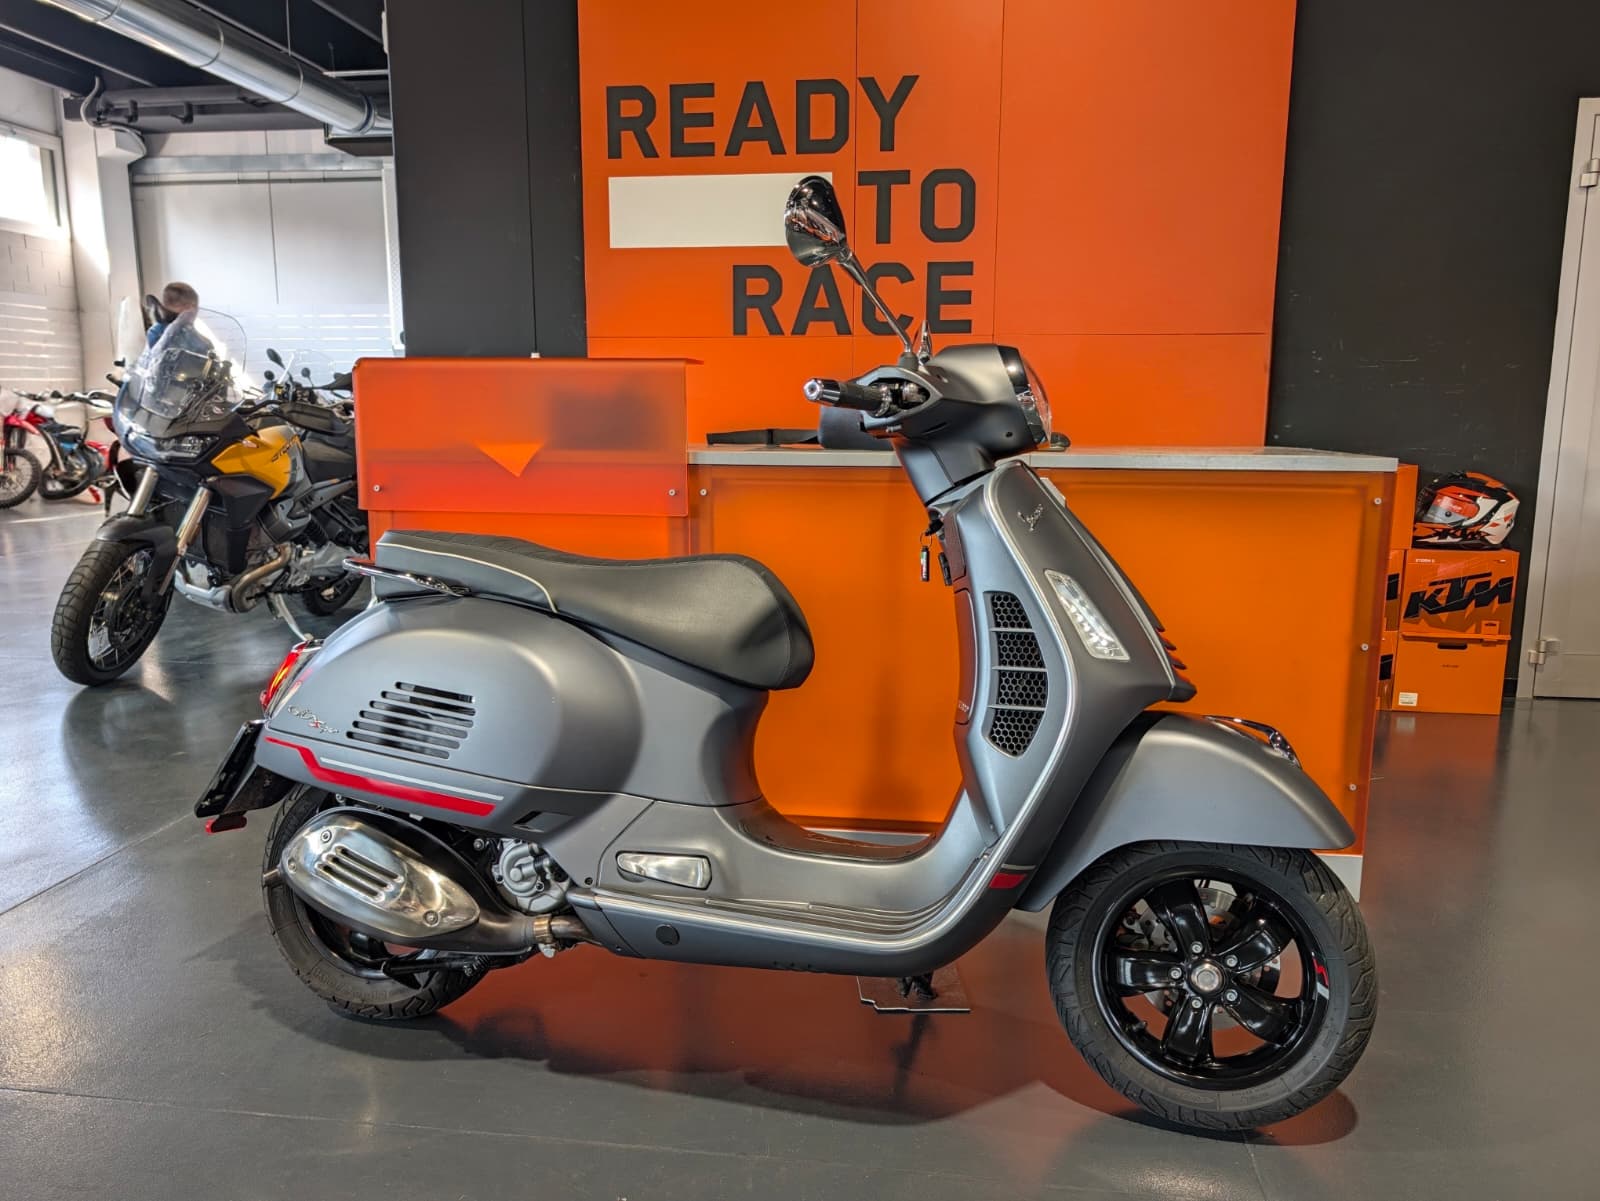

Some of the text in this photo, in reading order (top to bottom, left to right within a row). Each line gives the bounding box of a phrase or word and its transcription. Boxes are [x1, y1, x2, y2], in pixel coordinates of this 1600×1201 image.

[606, 75, 919, 159] READY
[857, 168, 976, 244] TO
[732, 261, 974, 336] RACE
[1403, 572, 1514, 619] KTM
